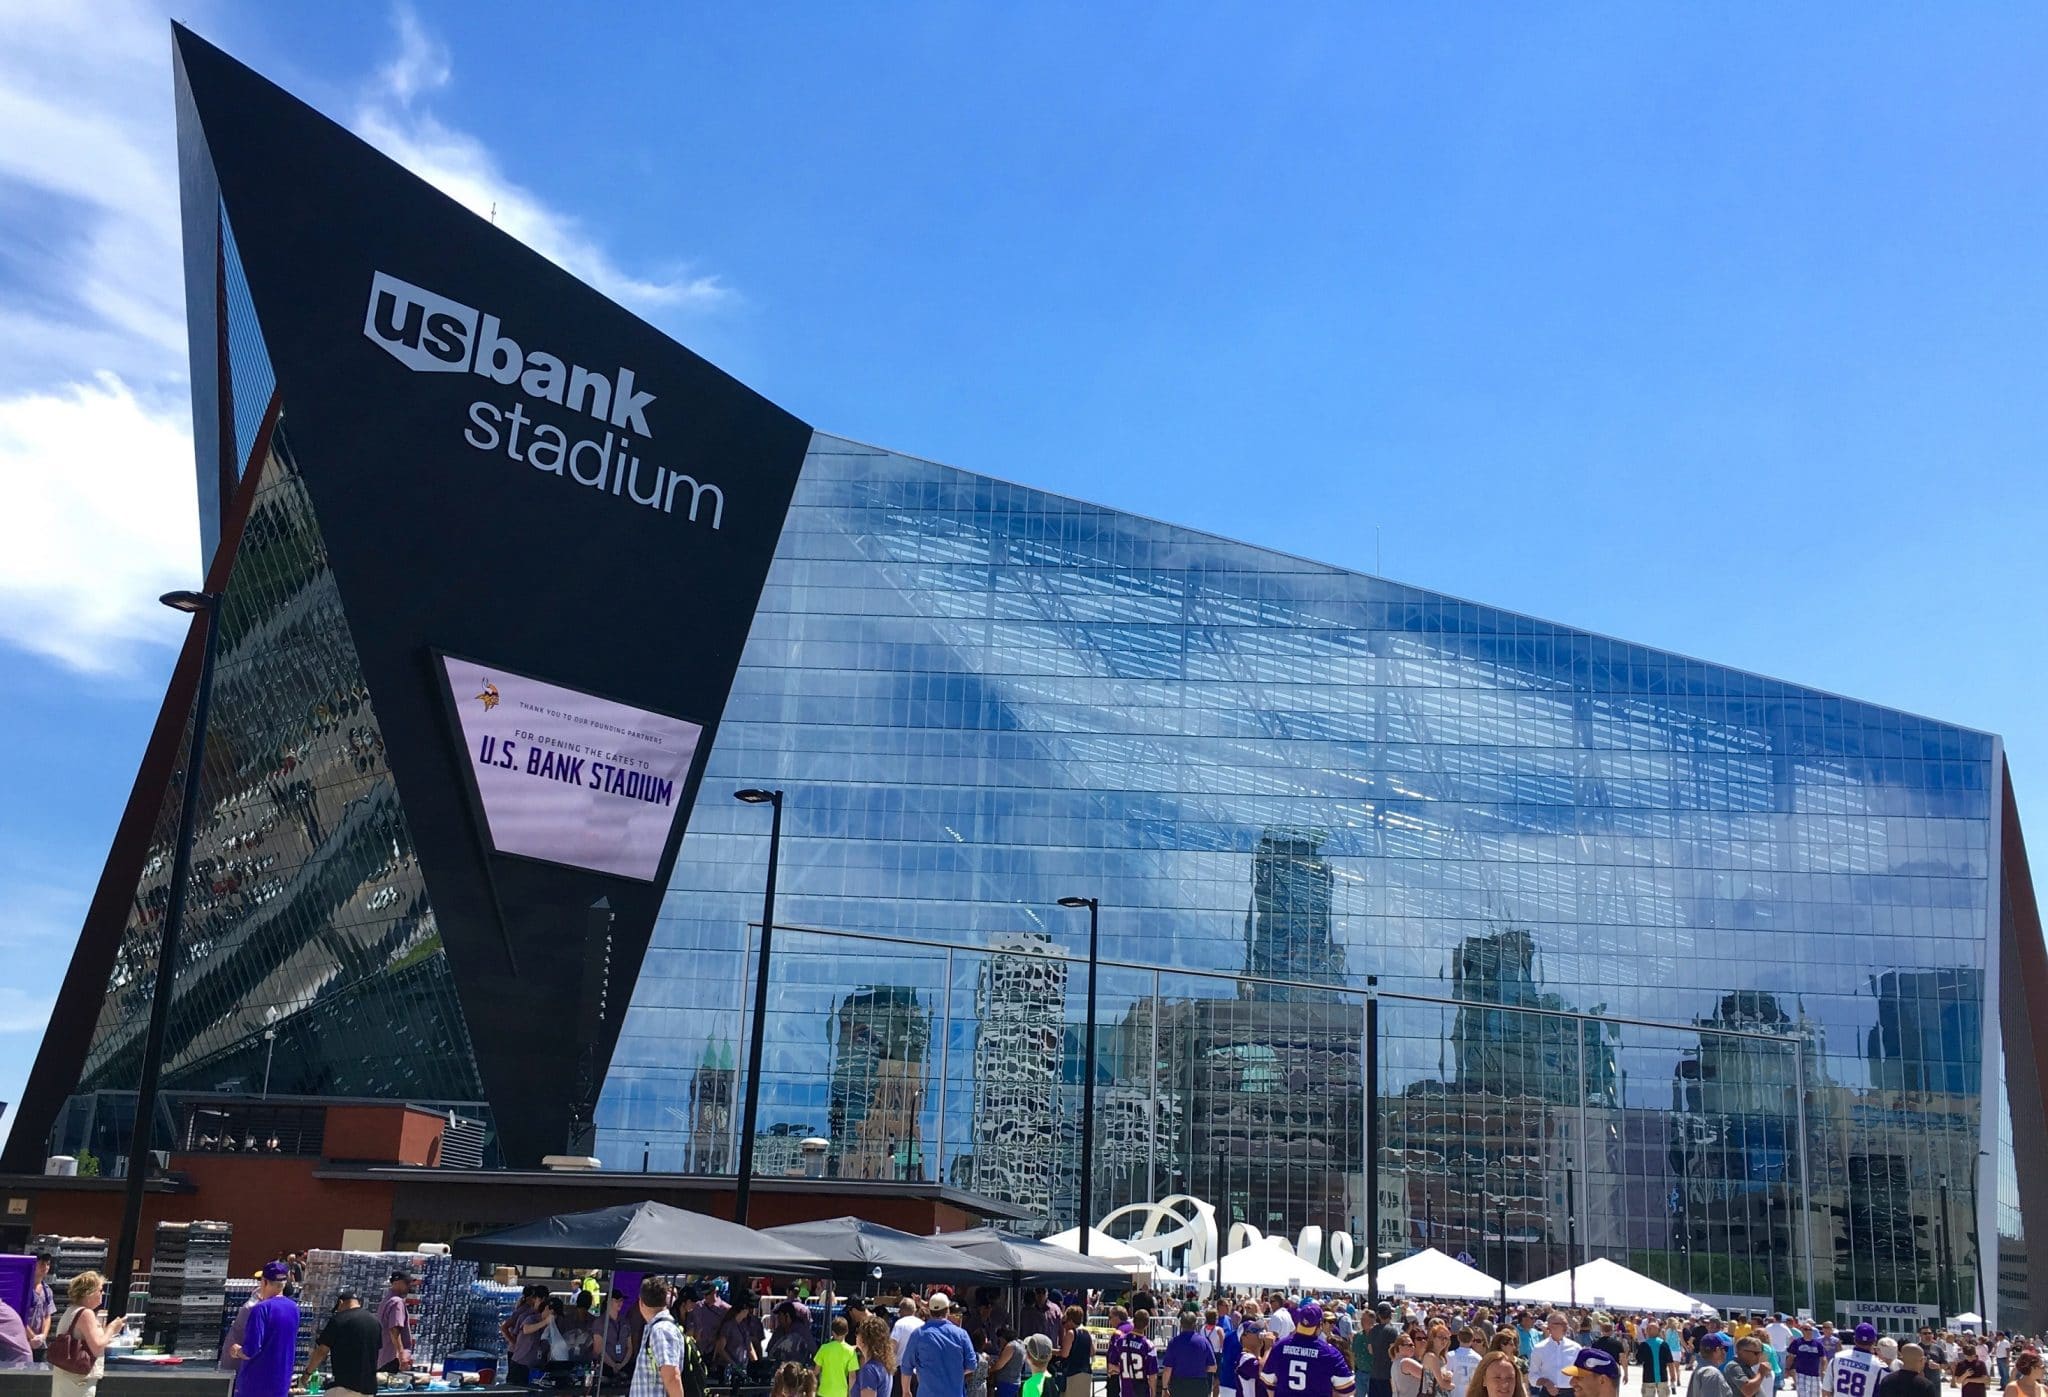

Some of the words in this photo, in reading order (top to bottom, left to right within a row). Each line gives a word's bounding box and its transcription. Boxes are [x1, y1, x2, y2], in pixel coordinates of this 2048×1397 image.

[463, 401, 724, 530] stadium
[520, 702, 544, 714] THANK
[547, 709, 561, 718] YOU
[563, 713, 572, 721] TO
[574, 716, 588, 725] OUR
[590, 720, 626, 736] FOUNDING
[627, 730, 663, 745] PARTNERS
[515, 729, 534, 741] FOR
[538, 735, 581, 753] OPENING
[585, 746, 603, 758] THE
[605, 752, 635, 767] GATES
[638, 760, 650, 770] TO
[480, 735, 518, 771] U.S.
[526, 746, 585, 786] BANK
[589, 762, 674, 807] STADIUM
[1856, 1303, 1891, 1313] LEGACY
[1893, 1305, 1919, 1315] GATE
[1120, 1351, 1144, 1379] 12
[1288, 1359, 1307, 1391] 5
[1836, 1368, 1867, 1397] 28
